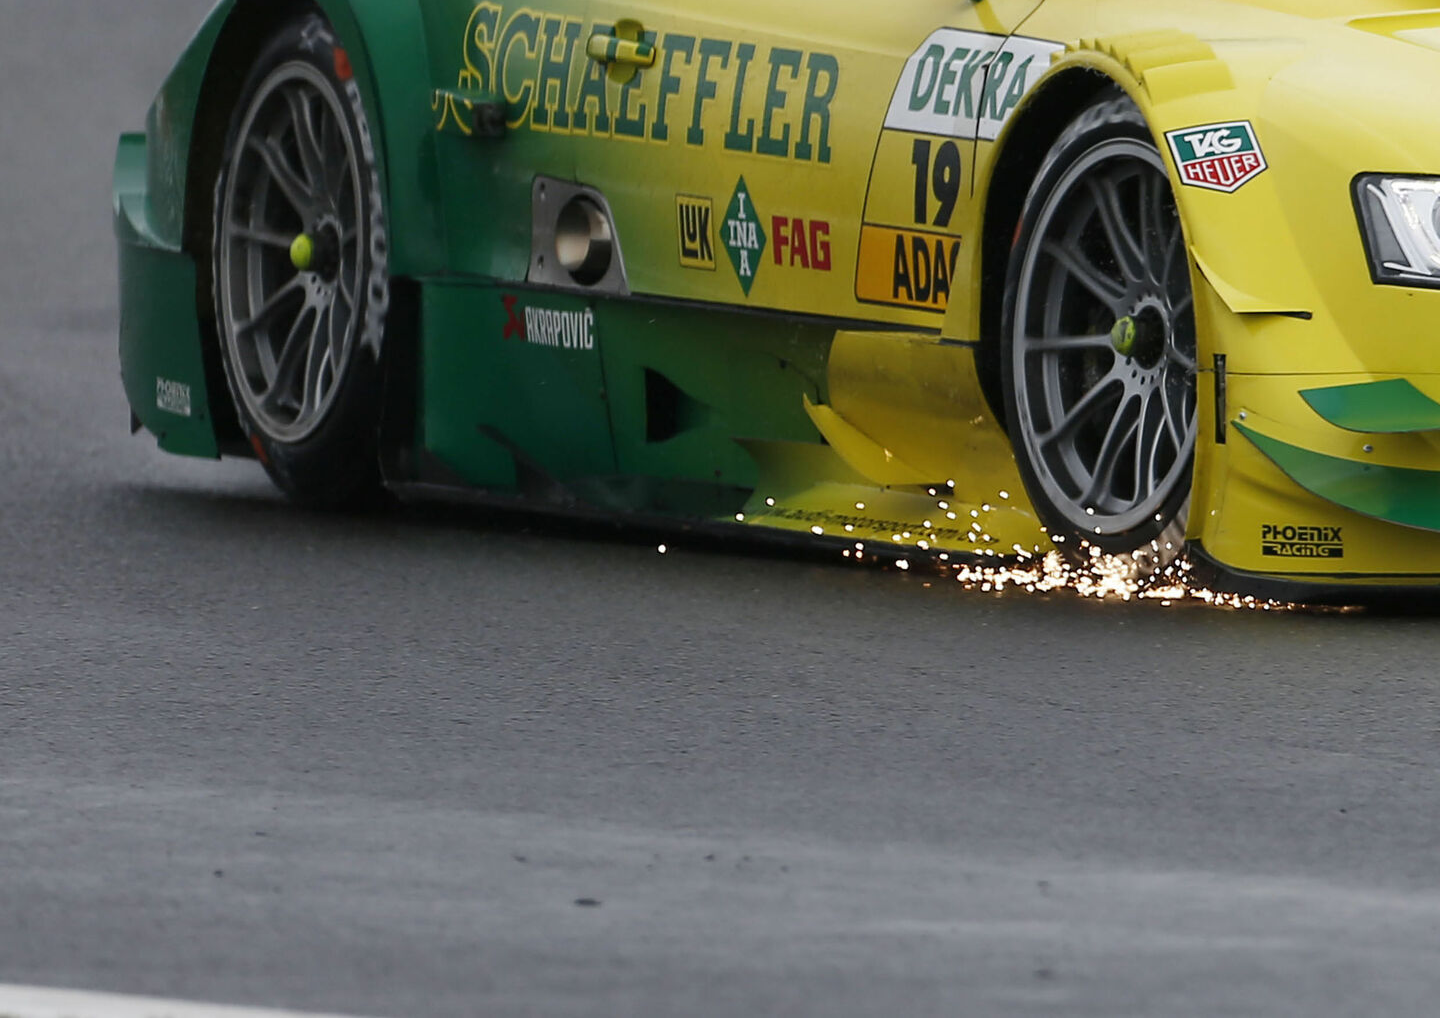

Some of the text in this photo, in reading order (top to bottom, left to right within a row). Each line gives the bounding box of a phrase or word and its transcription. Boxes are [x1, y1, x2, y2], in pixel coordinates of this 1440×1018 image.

[436, 1, 839, 165] SCHAEFFLER
[908, 44, 1034, 121] DEKRA
[1184, 129, 1242, 157] TAG
[1187, 155, 1258, 184] HEUER
[912, 139, 960, 227] 19
[772, 215, 831, 271] FAG
